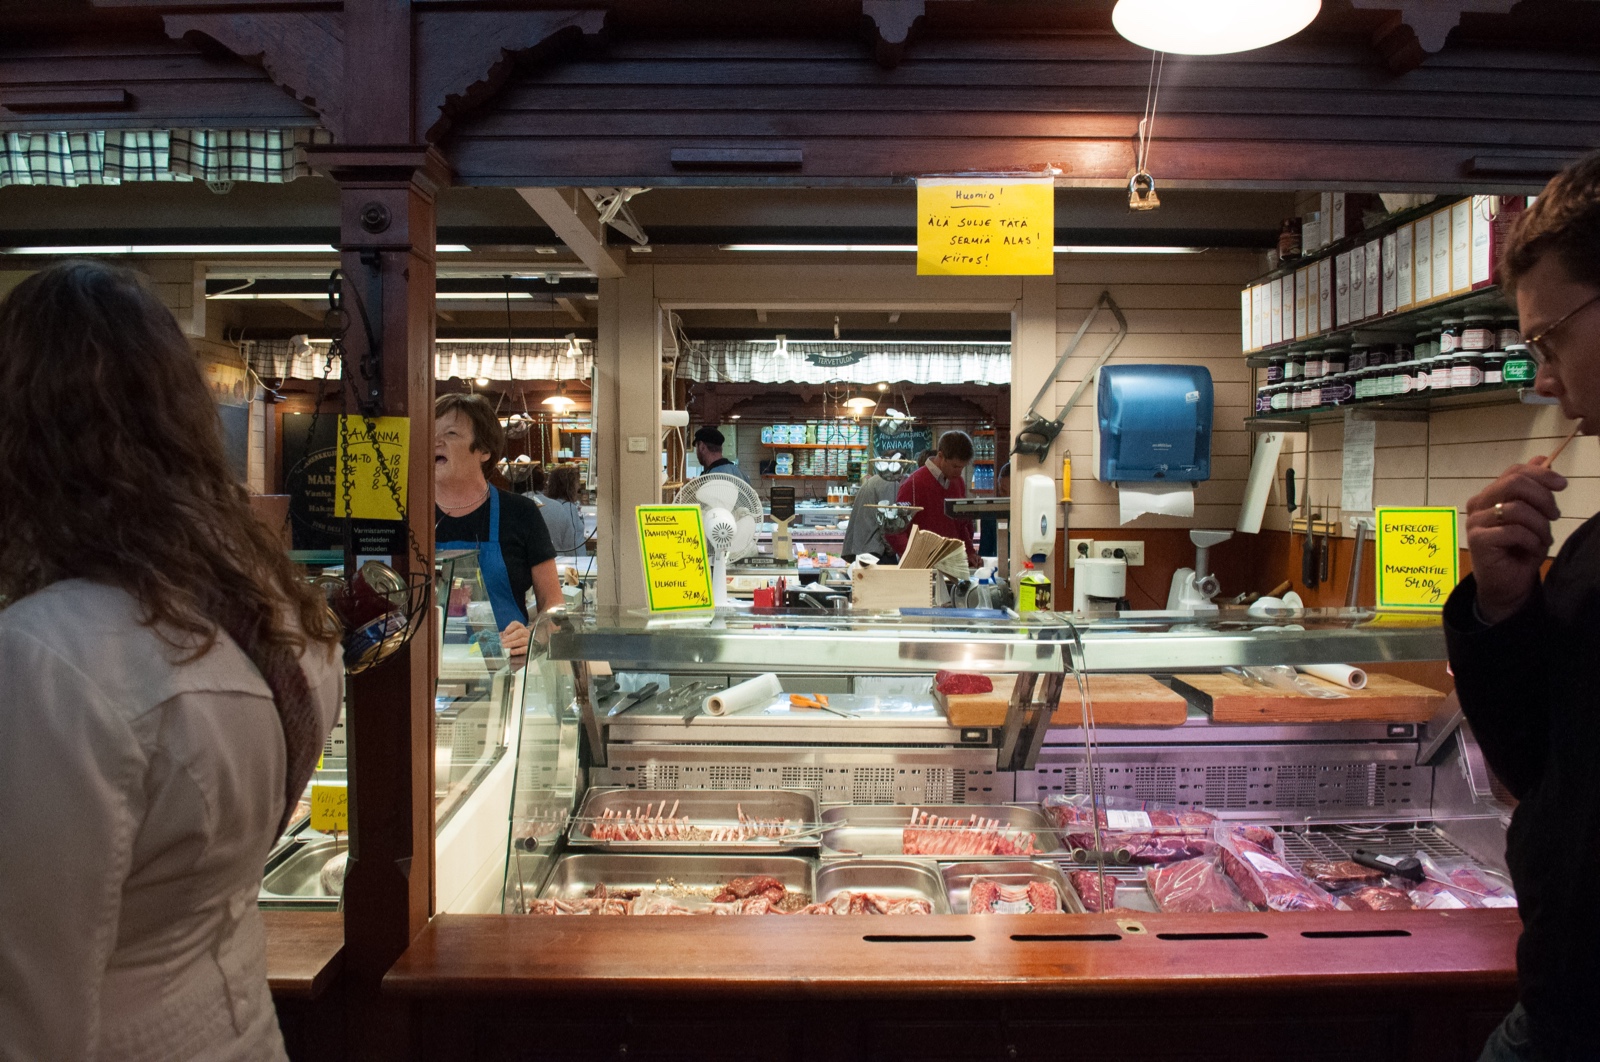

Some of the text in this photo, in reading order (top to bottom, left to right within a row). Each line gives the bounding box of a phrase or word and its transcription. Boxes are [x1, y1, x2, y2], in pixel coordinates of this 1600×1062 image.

[927, 213, 1028, 228] ÄLÄ SULJE TÄTÄ
[1003, 232, 1040, 250] ALAS!
[818, 355, 855, 366] TERVETULOA
[645, 513, 677, 523] KARITSA
[1384, 524, 1440, 534] ENTRECOTE
[649, 552, 668, 560] KARE
[1385, 564, 1449, 575] MARMORIFILE
[654, 580, 688, 588] ULKOFILE
